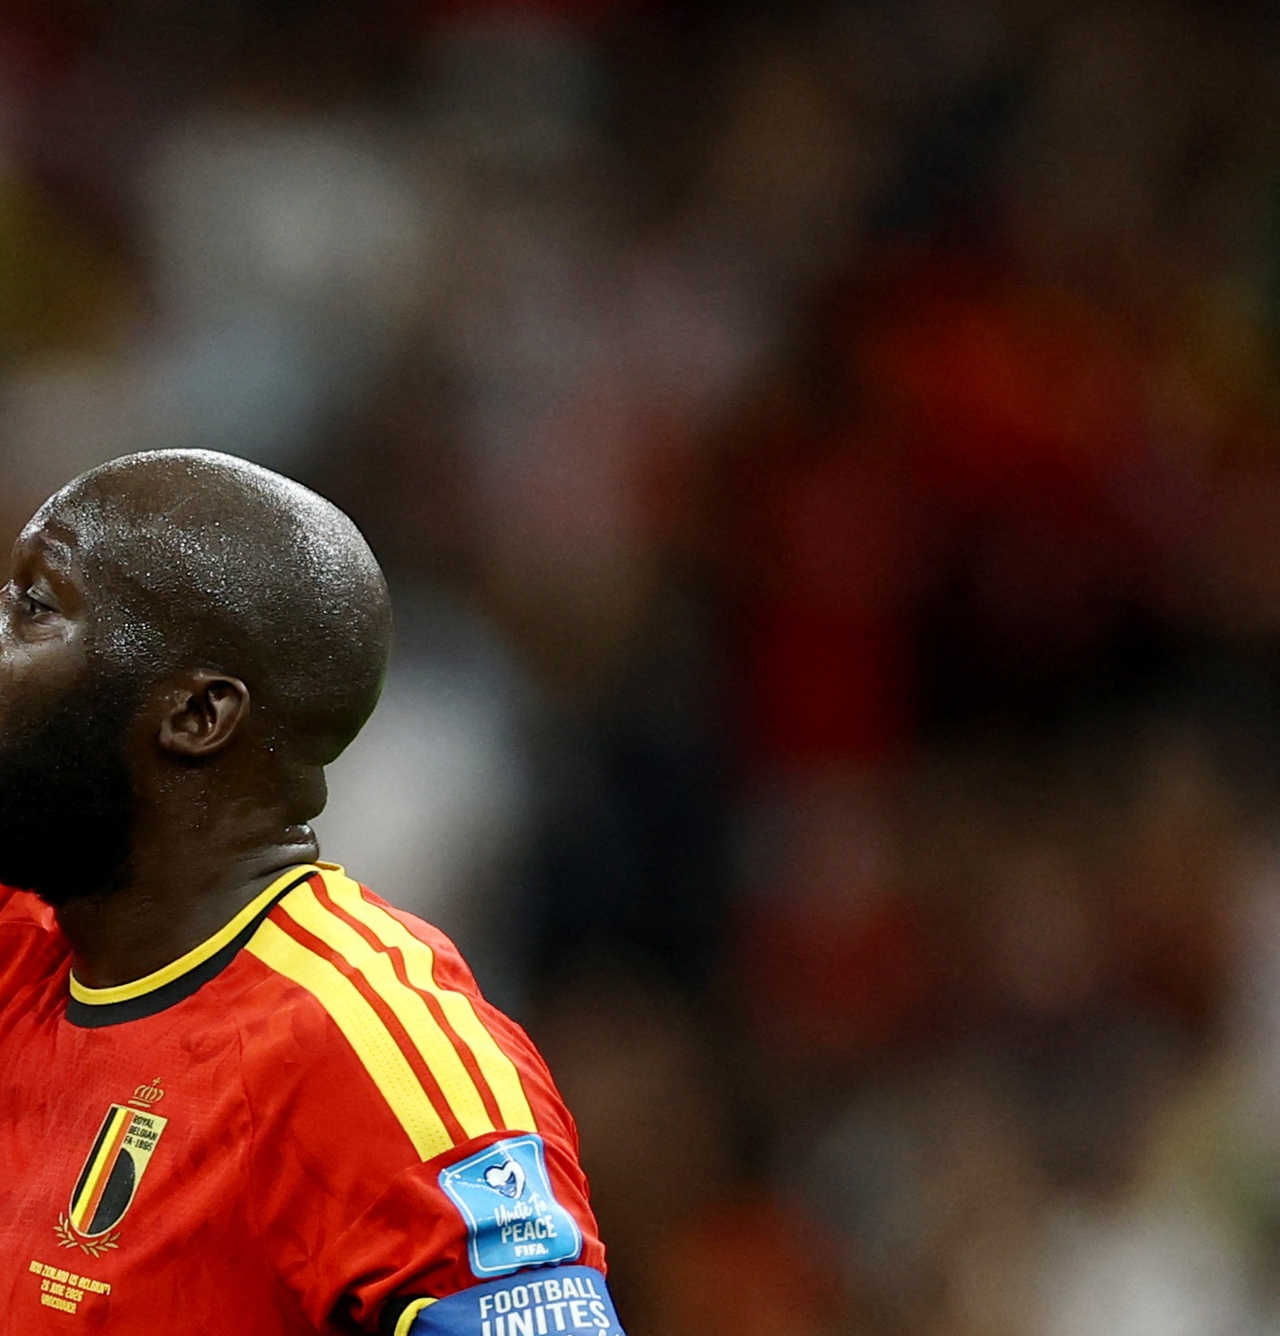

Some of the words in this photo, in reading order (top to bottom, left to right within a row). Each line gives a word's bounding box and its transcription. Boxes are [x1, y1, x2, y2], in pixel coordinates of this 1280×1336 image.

[501, 1215, 558, 1244] PEACE
[514, 1243, 549, 1257] FIFA
[479, 1277, 602, 1319] FOOTBALL
